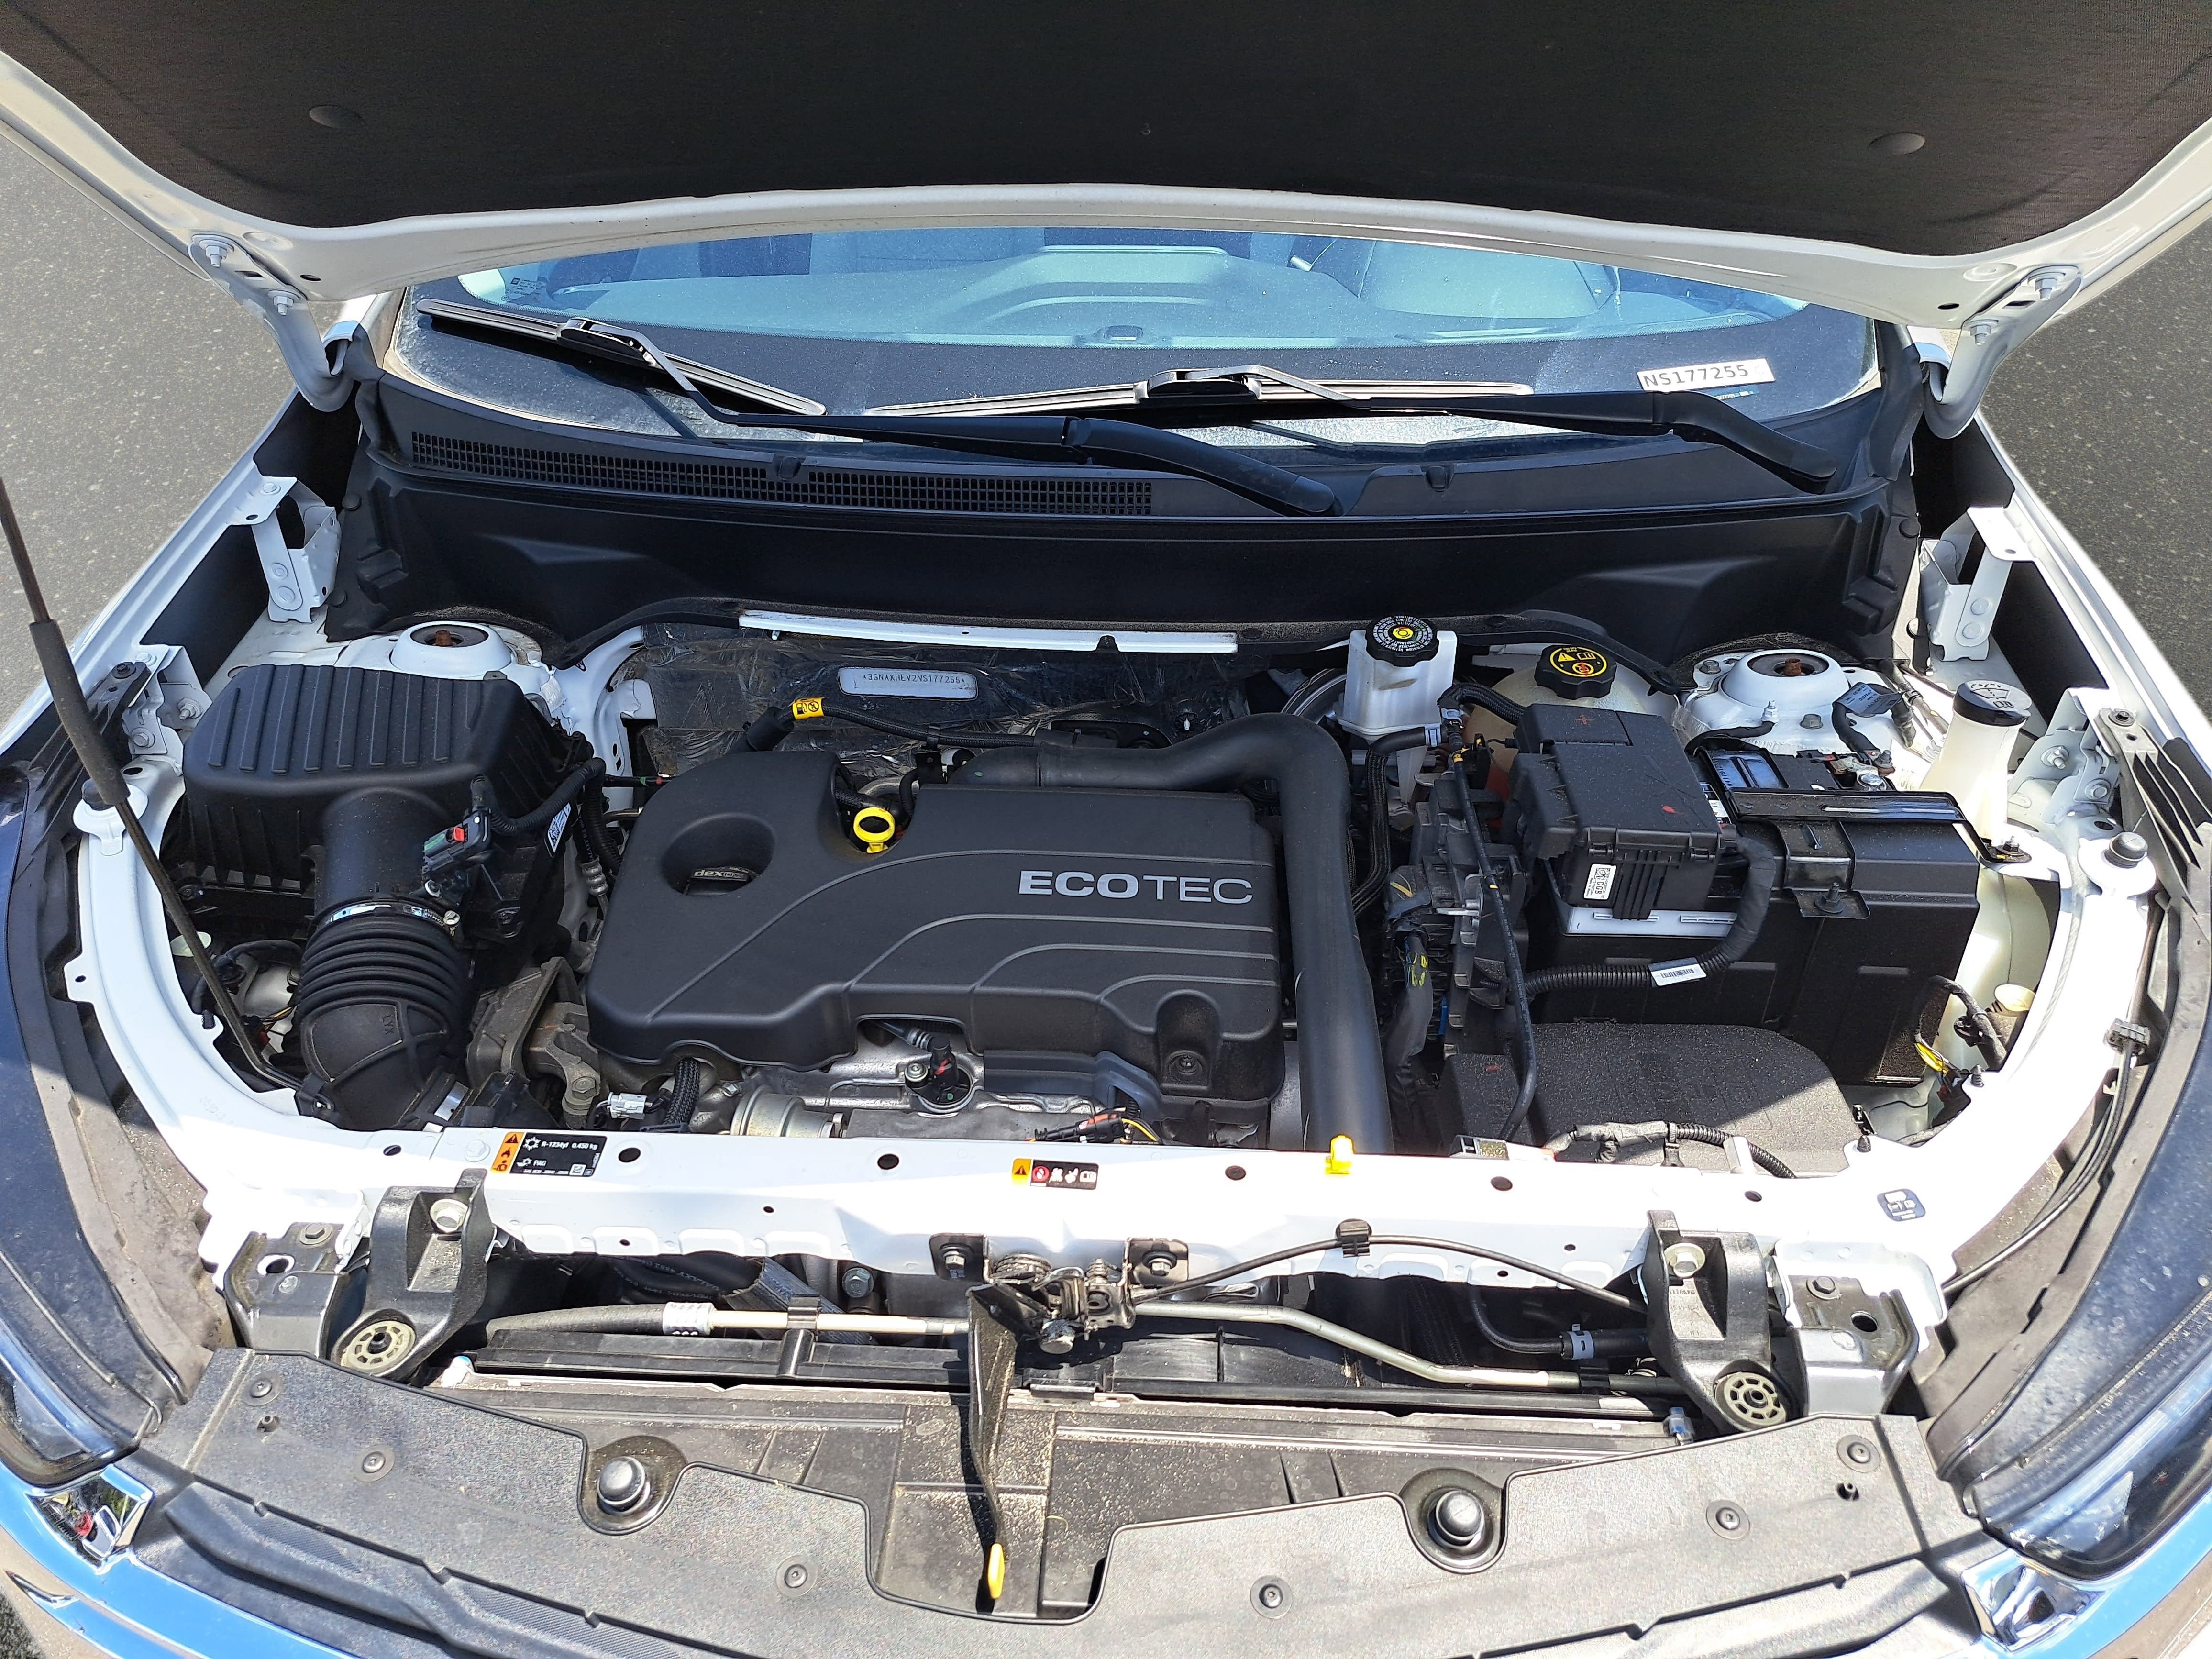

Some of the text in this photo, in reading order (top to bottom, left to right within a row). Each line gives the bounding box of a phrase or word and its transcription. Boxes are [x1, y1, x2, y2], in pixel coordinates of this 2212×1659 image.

[1643, 364, 1749, 387] NS177255
[694, 869, 744, 879] dexos
[1018, 870, 1253, 904] ECOTEC
[1595, 881, 1604, 894] DGB
